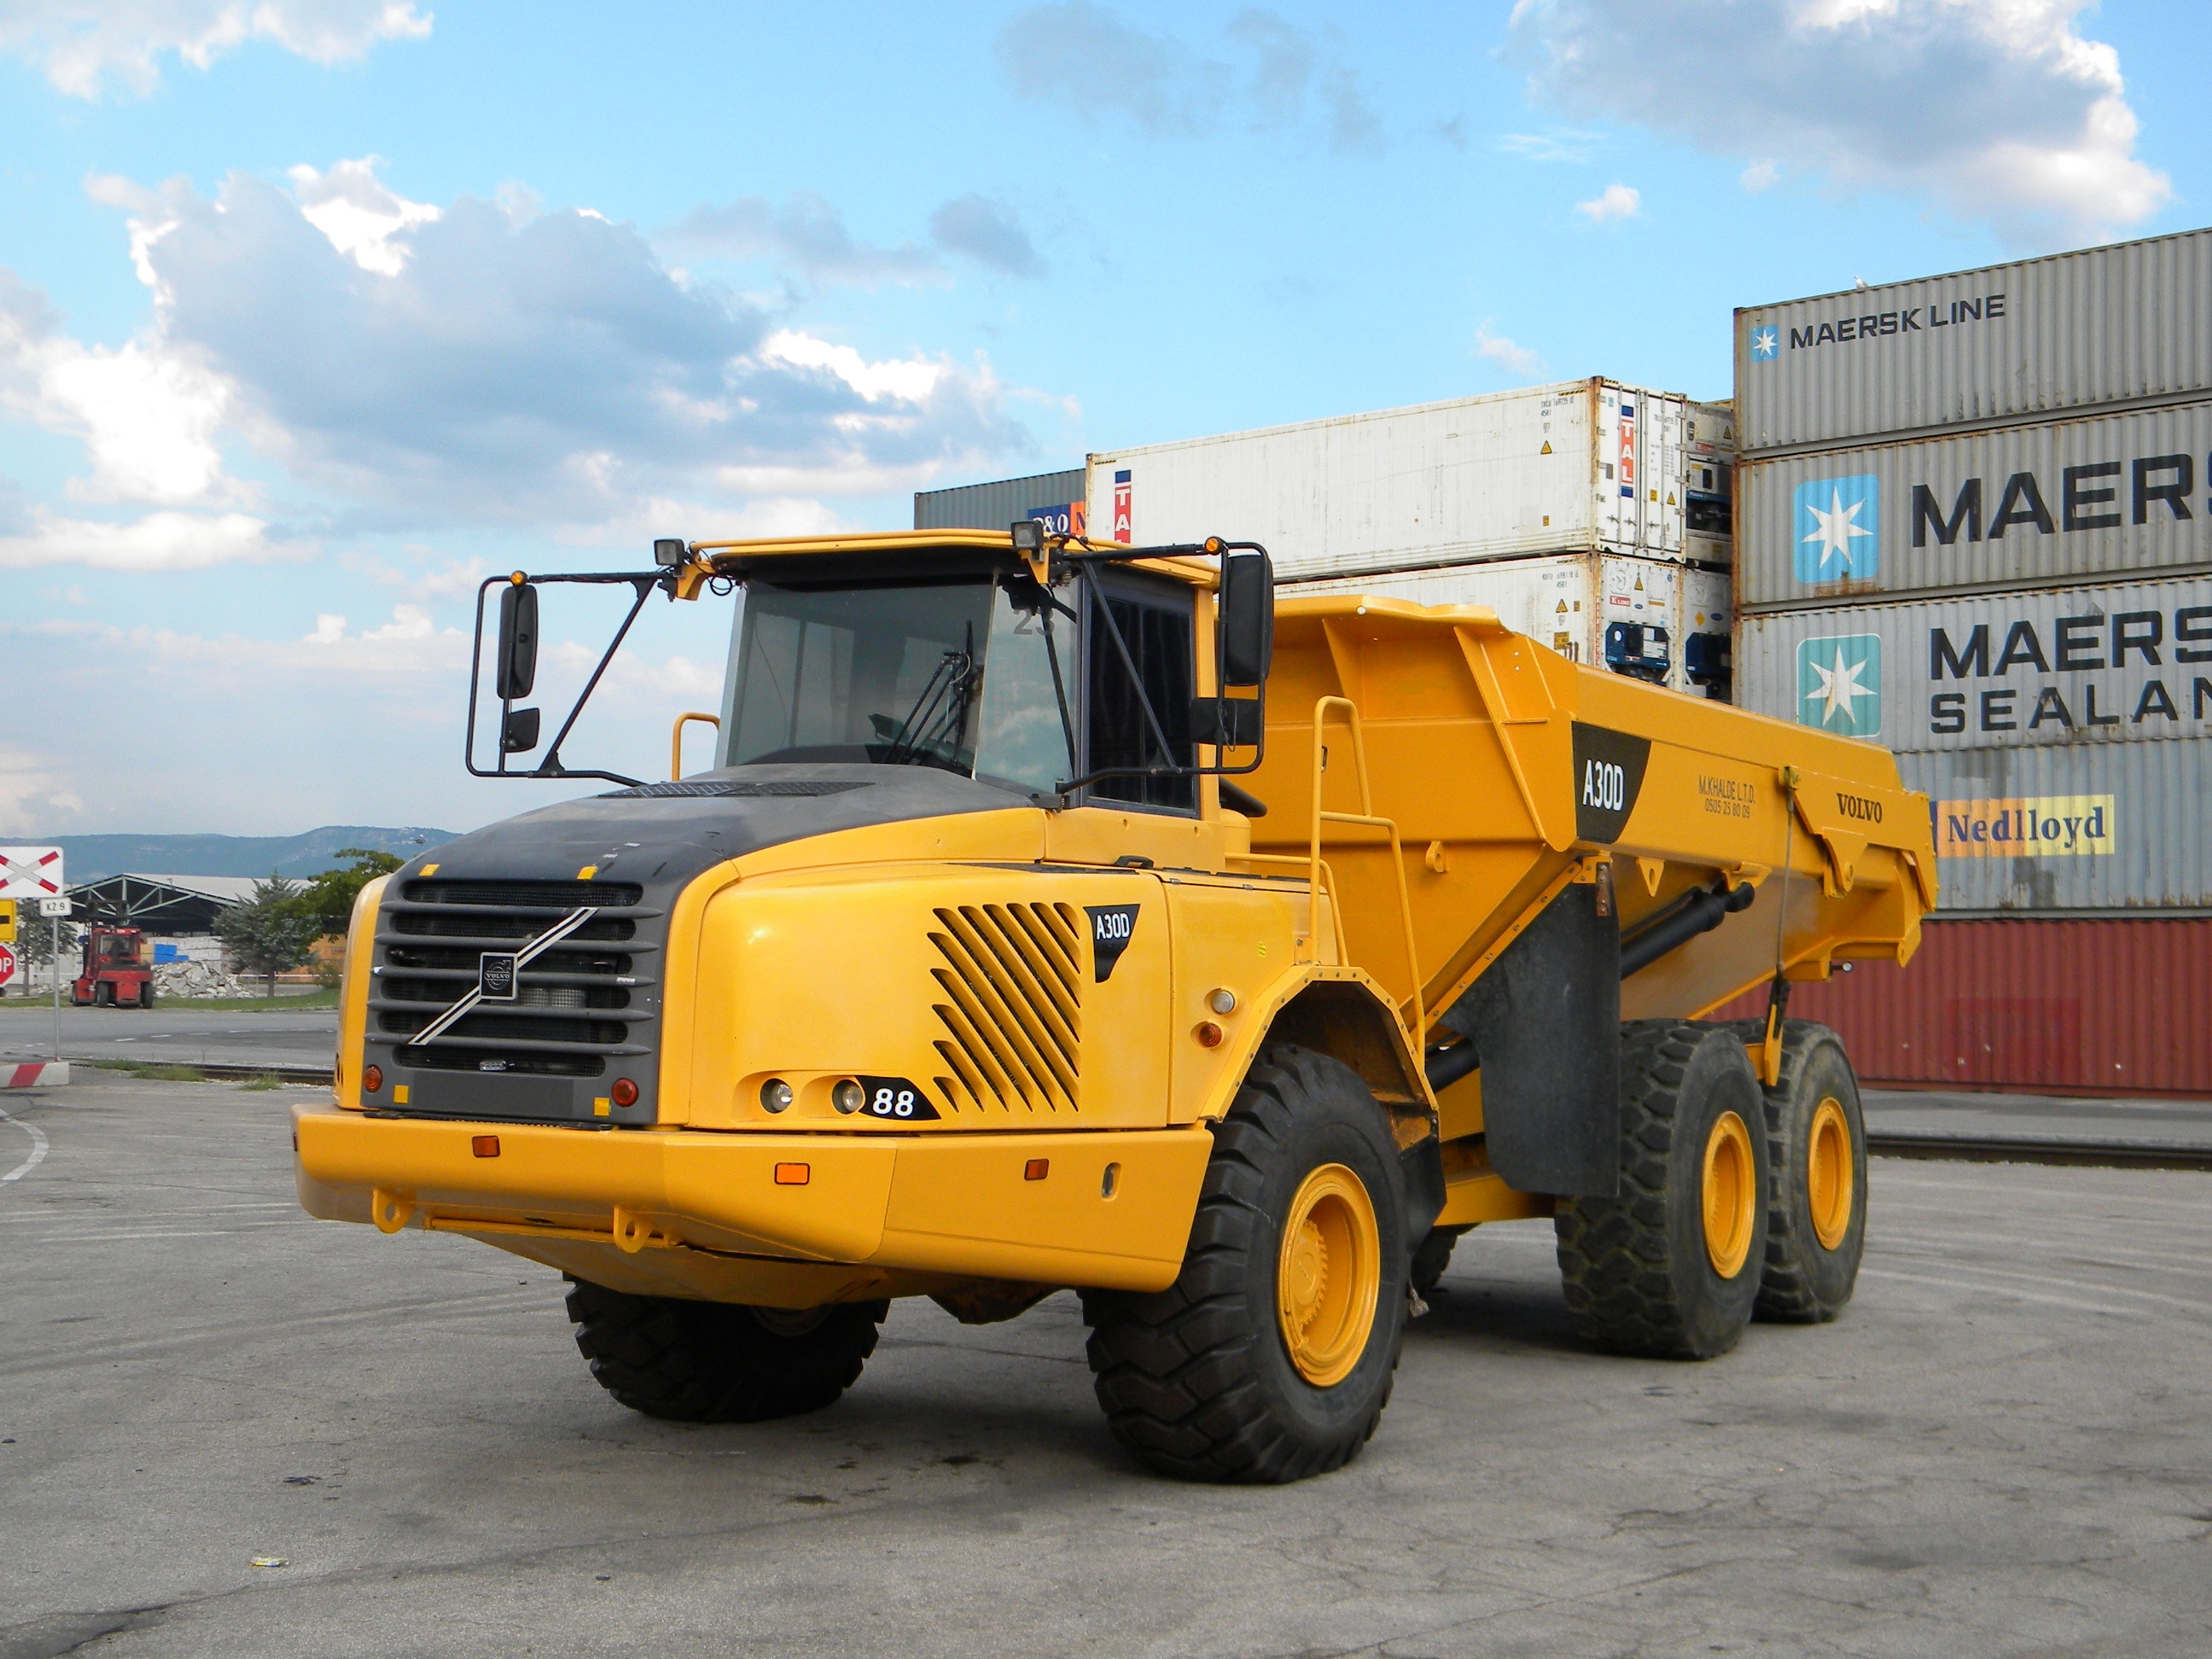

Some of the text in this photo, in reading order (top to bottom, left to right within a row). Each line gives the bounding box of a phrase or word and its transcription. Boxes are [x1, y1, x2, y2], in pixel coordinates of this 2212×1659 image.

[1790, 294, 2005, 350] MAERSK LINE
[1621, 421, 1633, 482] TAL
[1115, 488, 1131, 543] TA
[1912, 450, 2212, 548] MAER
[1582, 759, 1624, 812] A30D
[1705, 798, 1721, 814] 0505
[1723, 800, 1732, 815] 25
[1742, 804, 1750, 818] 09
[1837, 792, 1883, 824] VOLVO
[1947, 806, 2106, 848] Nedlloyd
[46, 902, 57, 911] KZ
[1097, 913, 1131, 940] A30D
[872, 1088, 914, 1116] 88
